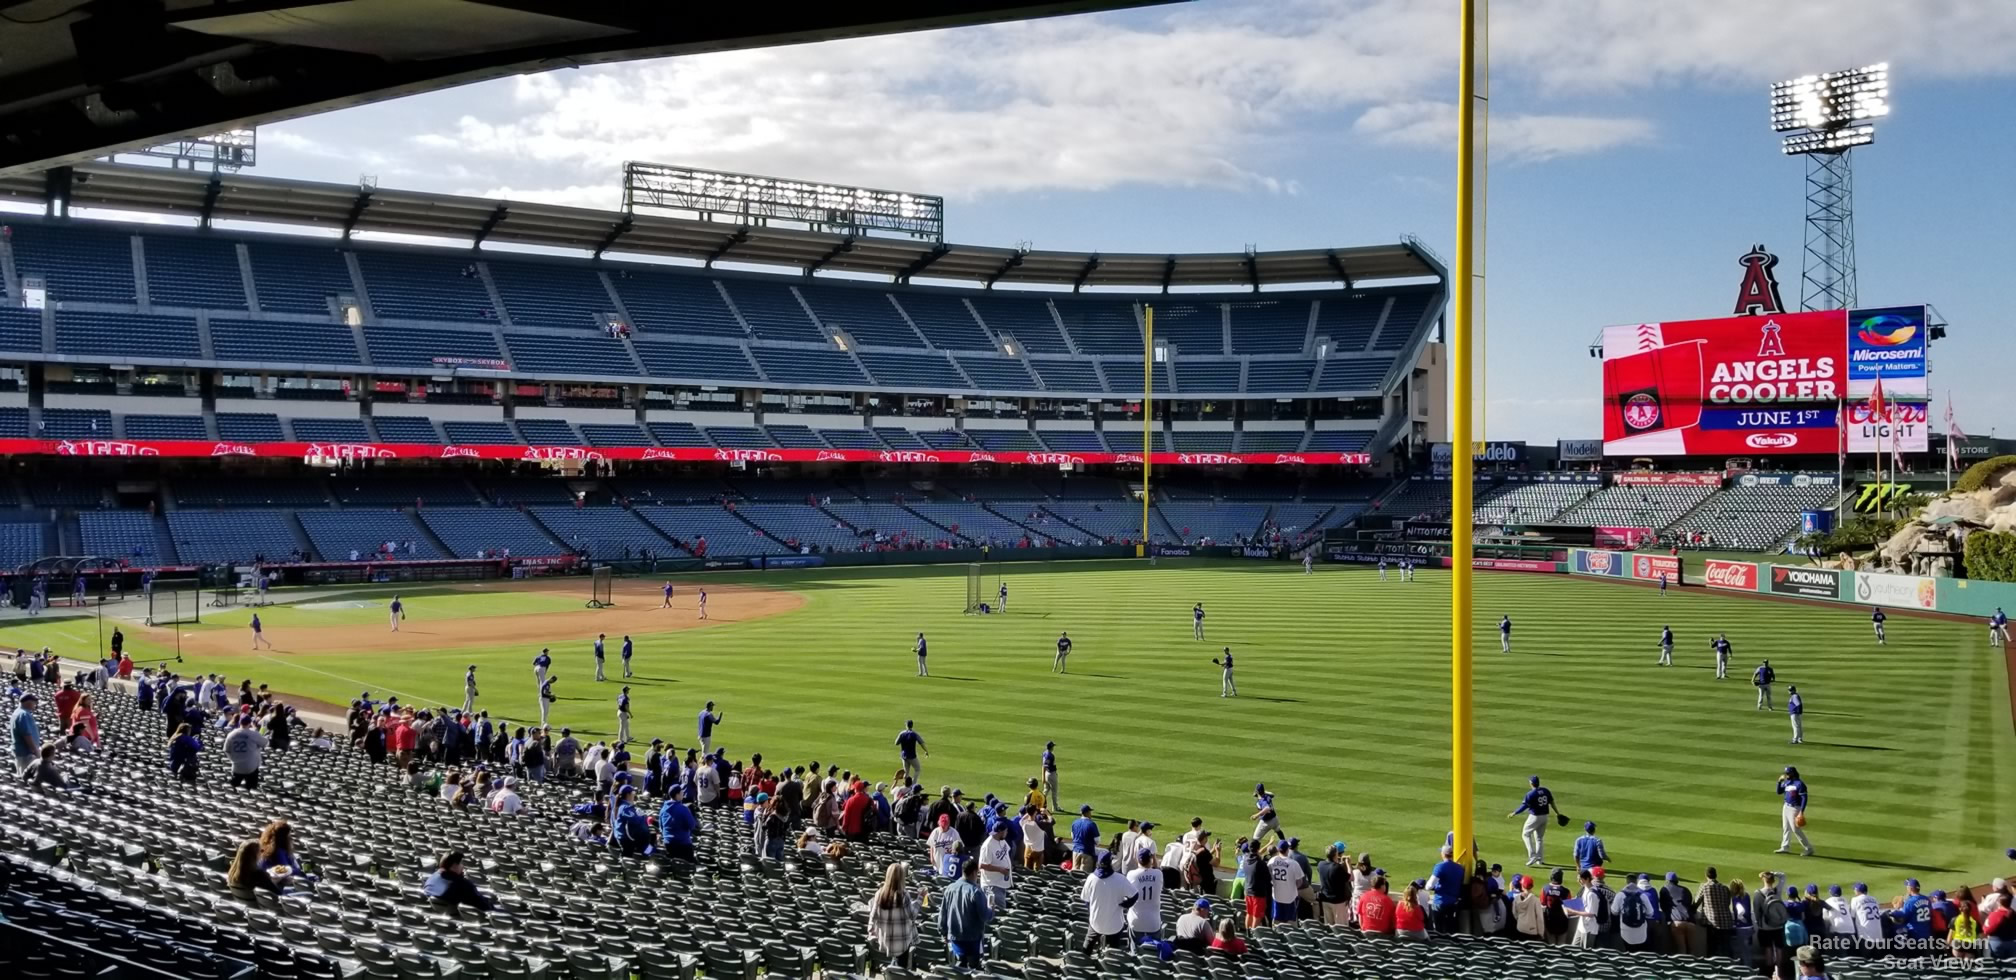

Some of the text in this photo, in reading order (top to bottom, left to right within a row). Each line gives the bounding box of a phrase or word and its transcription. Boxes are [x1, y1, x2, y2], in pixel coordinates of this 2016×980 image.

[1757, 320, 1786, 357] A
[1711, 357, 1835, 383] ANGELS
[1710, 380, 1837, 403] COOLER
[1737, 410, 1820, 426] JUNE 1ST
[1754, 437, 1790, 445] Yakult
[1566, 443, 1597, 455] Modelo
[1160, 548, 1190, 556] Fanatics
[1243, 548, 1269, 557] Modelo
[233, 741, 247, 752] 22
[1538, 795, 1548, 806] 99
[948, 864, 957, 877] 9
[1273, 868, 1287, 881] 22
[1138, 875, 1156, 883] HAREN
[1142, 886, 1153, 900] 11
[1366, 902, 1384, 920] 27
[1839, 904, 1847, 915] 5
[1864, 906, 1880, 920] 23
[1916, 907, 1930, 922] 22
